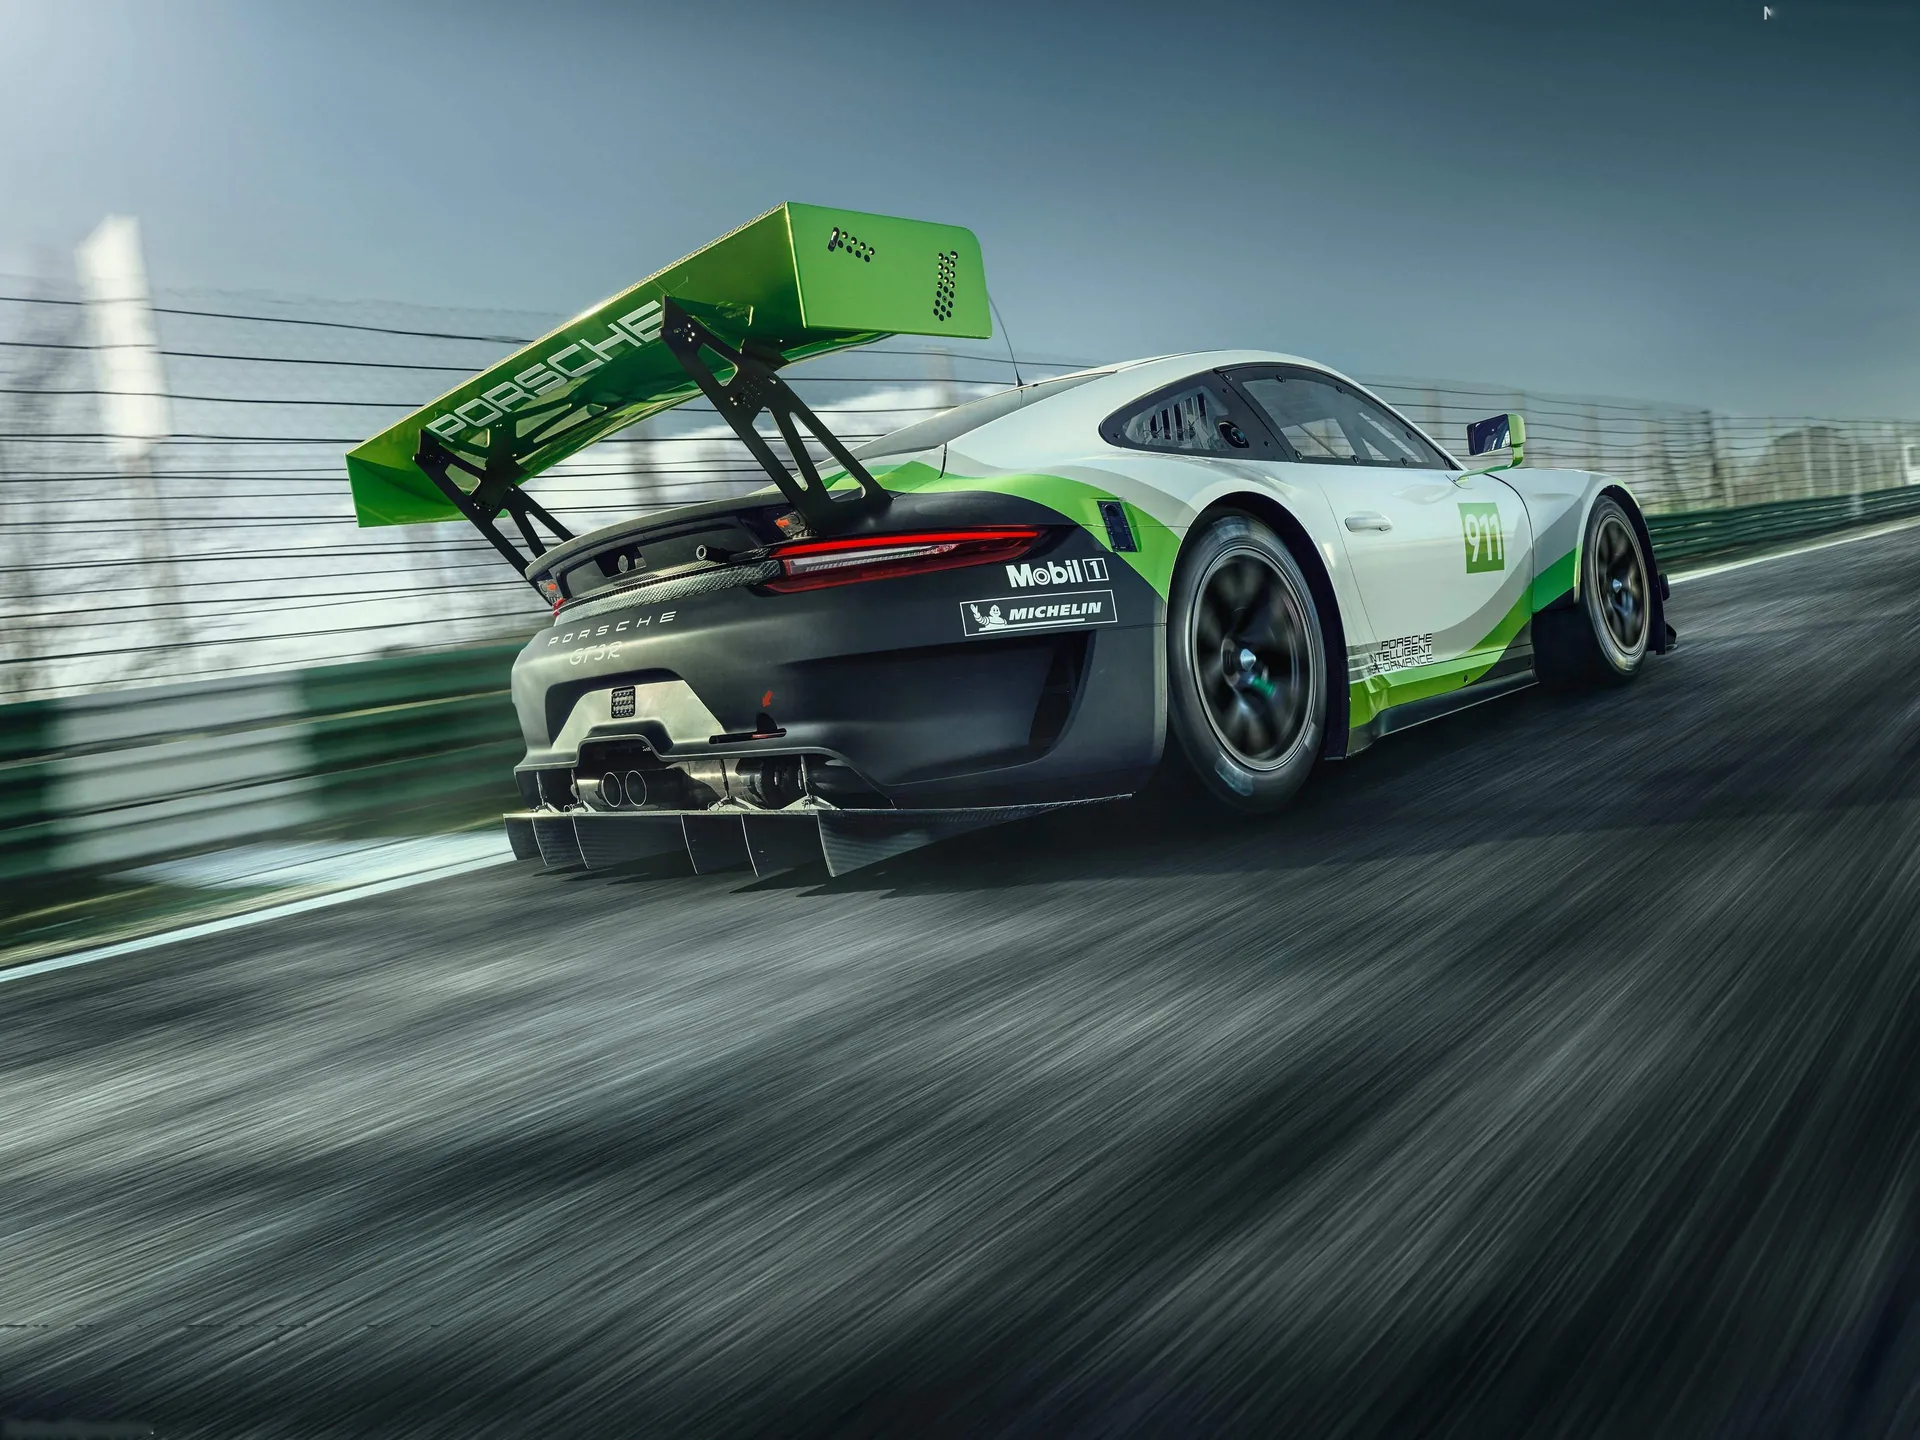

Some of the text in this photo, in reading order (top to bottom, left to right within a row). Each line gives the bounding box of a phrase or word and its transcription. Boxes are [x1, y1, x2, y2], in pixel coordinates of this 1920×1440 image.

[425, 299, 662, 443] PORSCHE
[1464, 513, 1503, 563] 911
[1005, 559, 1083, 588] Mobil
[1009, 602, 1102, 621] MICHELIN
[547, 610, 677, 647] PORSCHE
[1381, 633, 1433, 650] PORSCHE
[1367, 643, 1433, 664] NTELLIGENT
